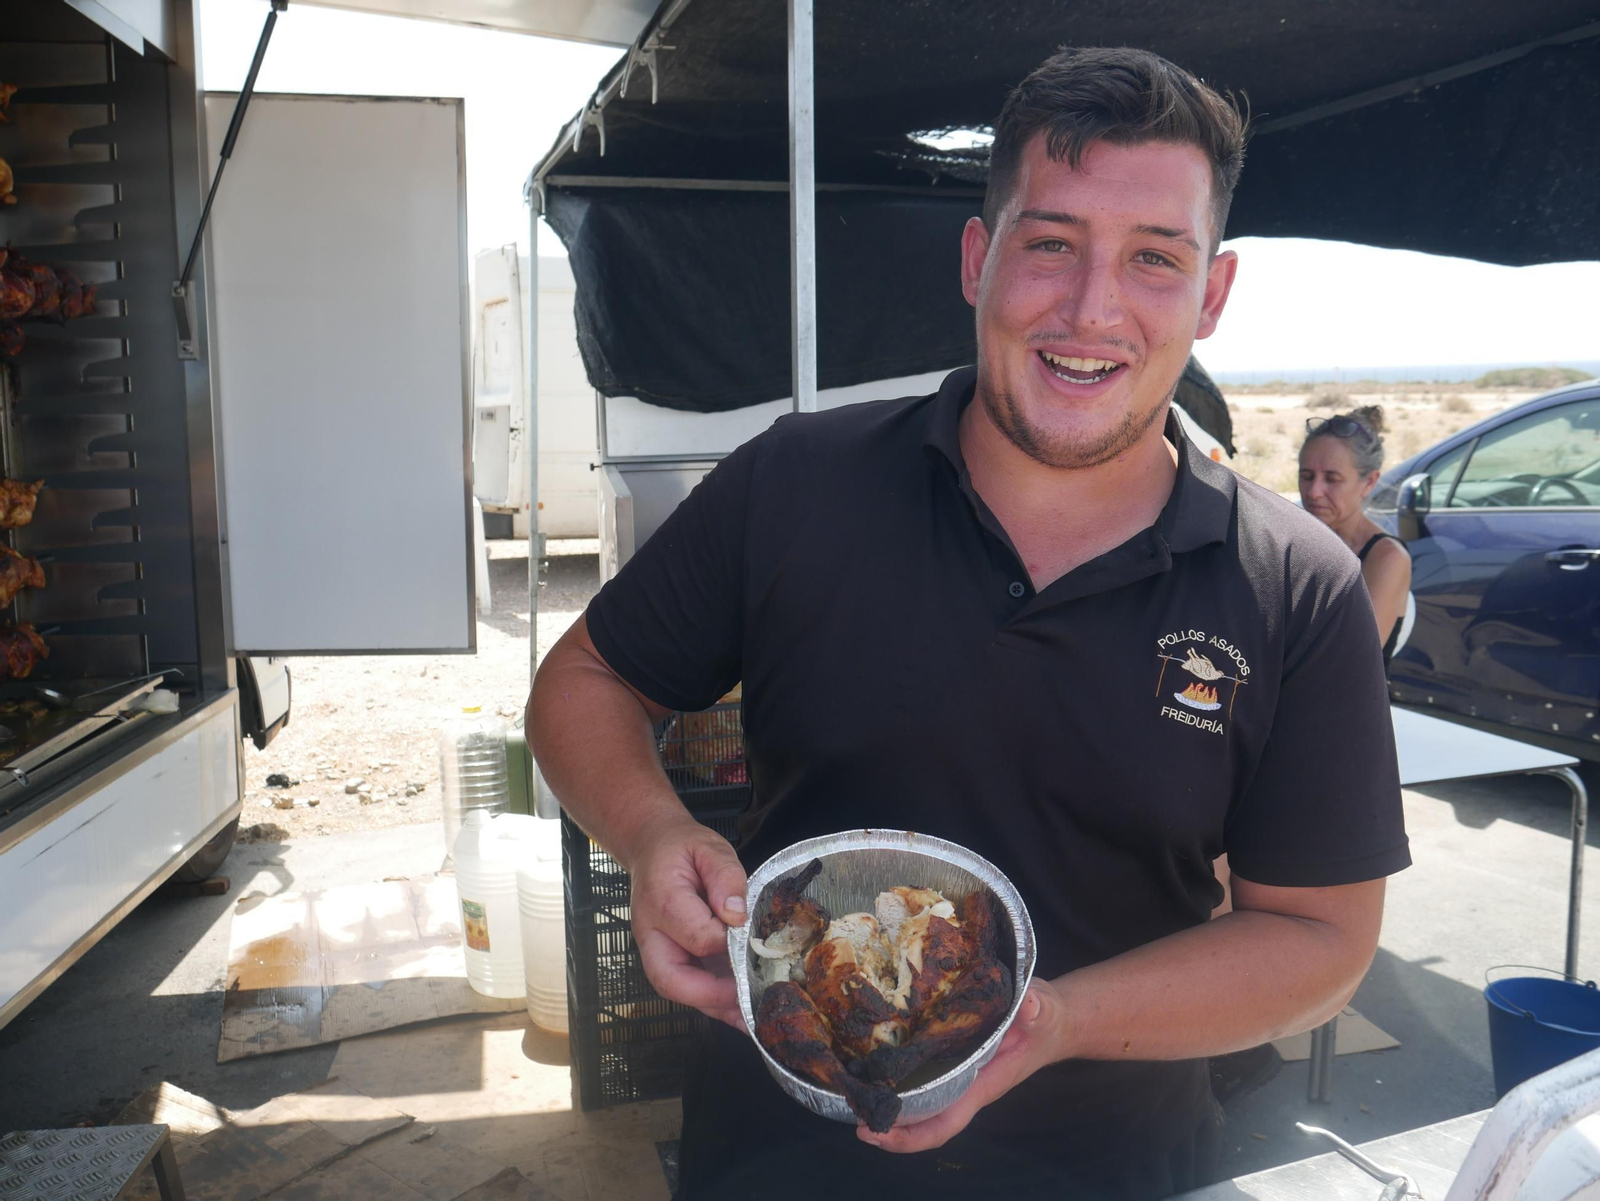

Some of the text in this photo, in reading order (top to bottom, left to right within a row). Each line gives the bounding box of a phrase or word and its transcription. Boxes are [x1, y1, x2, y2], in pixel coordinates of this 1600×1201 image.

[1157, 629, 1251, 677] POLLOS ASADOS
[1160, 706, 1225, 736] FREIDURÍA
